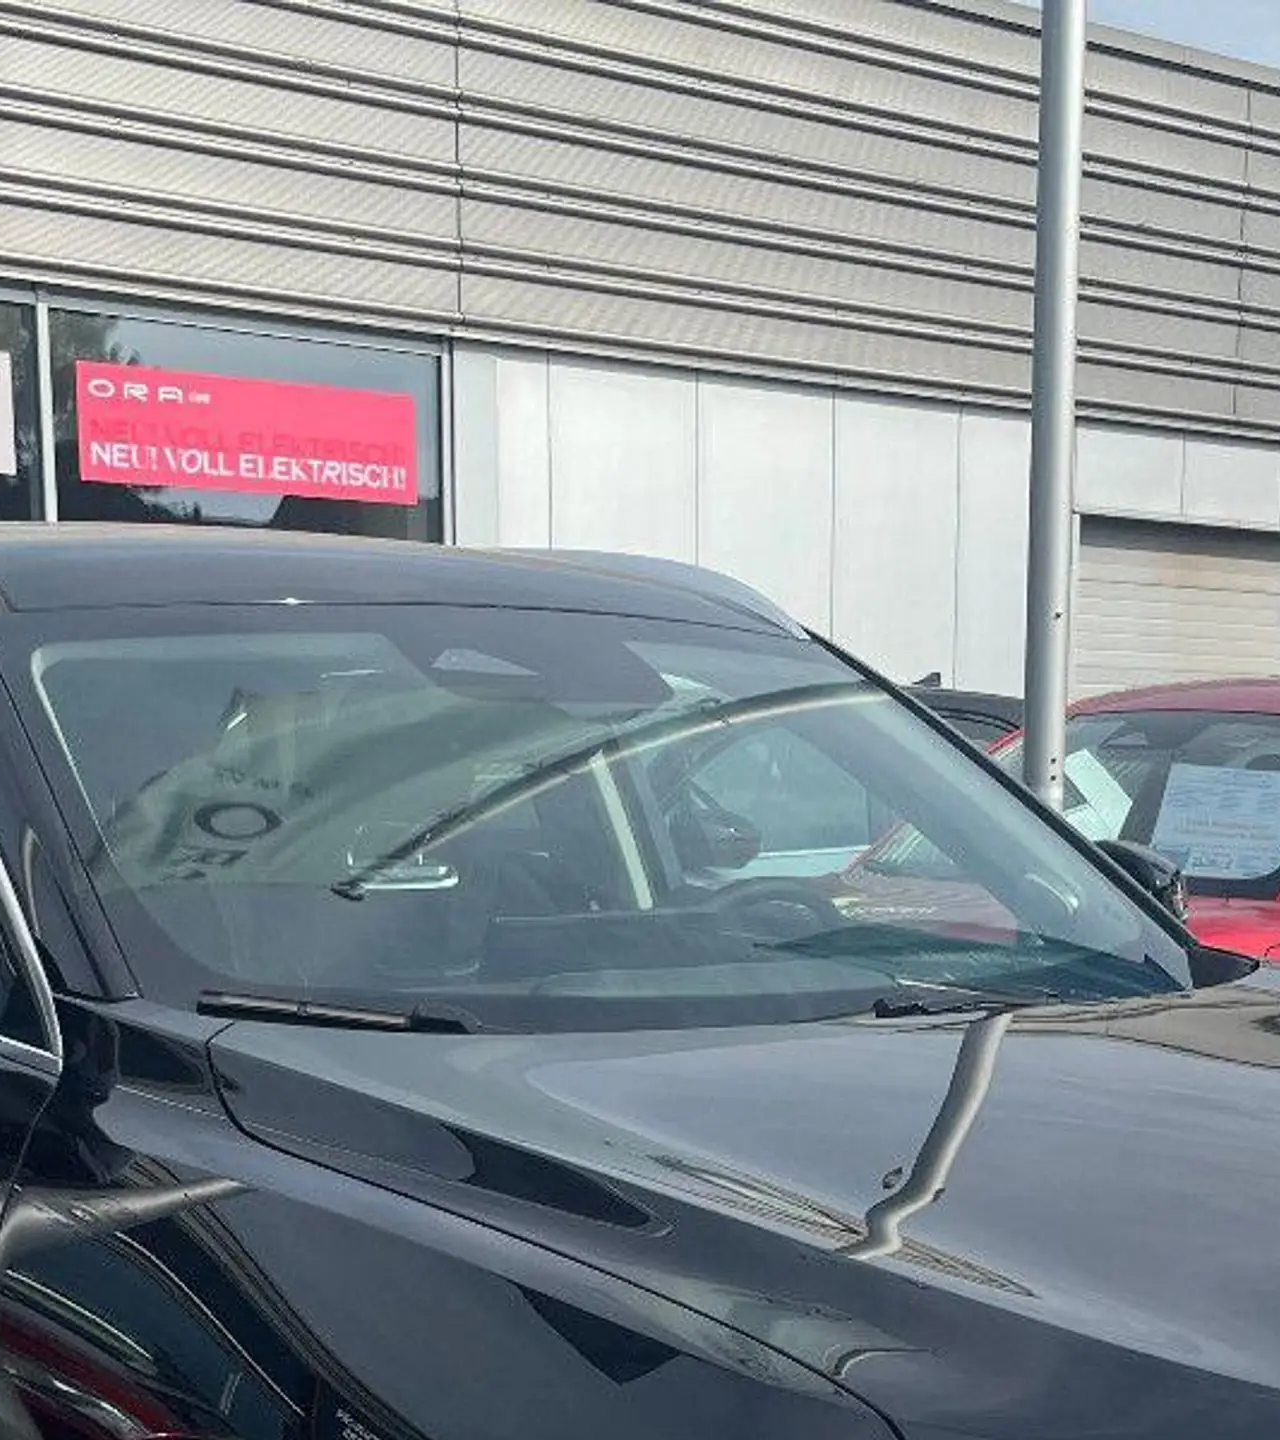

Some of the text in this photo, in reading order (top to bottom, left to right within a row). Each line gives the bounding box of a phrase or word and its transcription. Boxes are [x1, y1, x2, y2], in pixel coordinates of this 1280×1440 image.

[88, 378, 184, 404] ORA
[90, 441, 407, 491] NEU! VOLL ELEKTRISCH!
